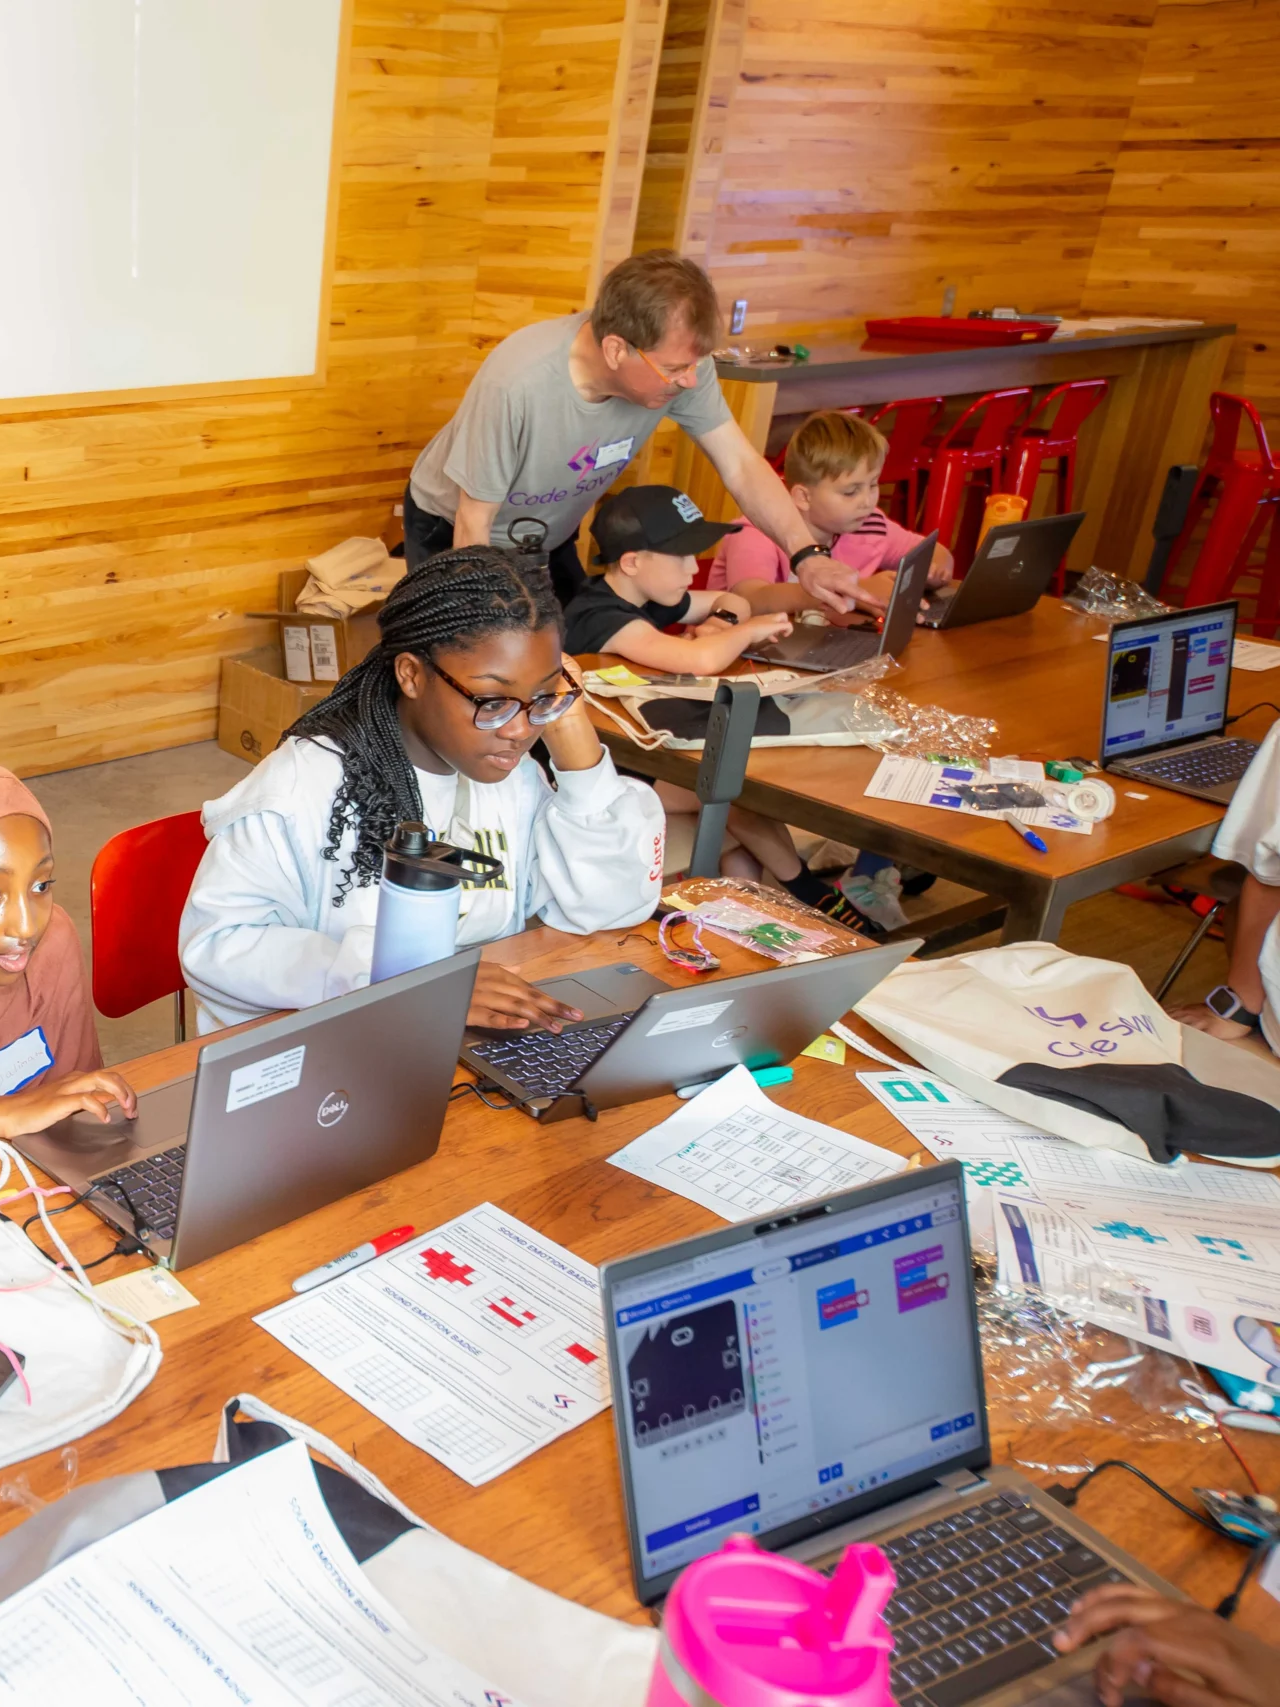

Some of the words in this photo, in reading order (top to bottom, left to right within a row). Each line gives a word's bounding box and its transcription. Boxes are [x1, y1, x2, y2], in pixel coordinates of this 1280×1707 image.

[508, 487, 568, 506] Code
[322, 1100, 345, 1117] DELL
[497, 1226, 527, 1247] SOUND
[527, 1244, 567, 1271] EMOTION
[567, 1269, 598, 1289] BADGE
[382, 1286, 412, 1307] SOUND
[411, 1306, 451, 1335] EMOTION
[450, 1334, 482, 1356] BADGE
[291, 1496, 315, 1541] SOUND
[312, 1543, 355, 1598] EMOTION
[353, 1598, 391, 1634] BADGE
[126, 1579, 164, 1616] SOUND
[162, 1615, 215, 1667] EMOTION
[213, 1666, 252, 1705] BADGE
